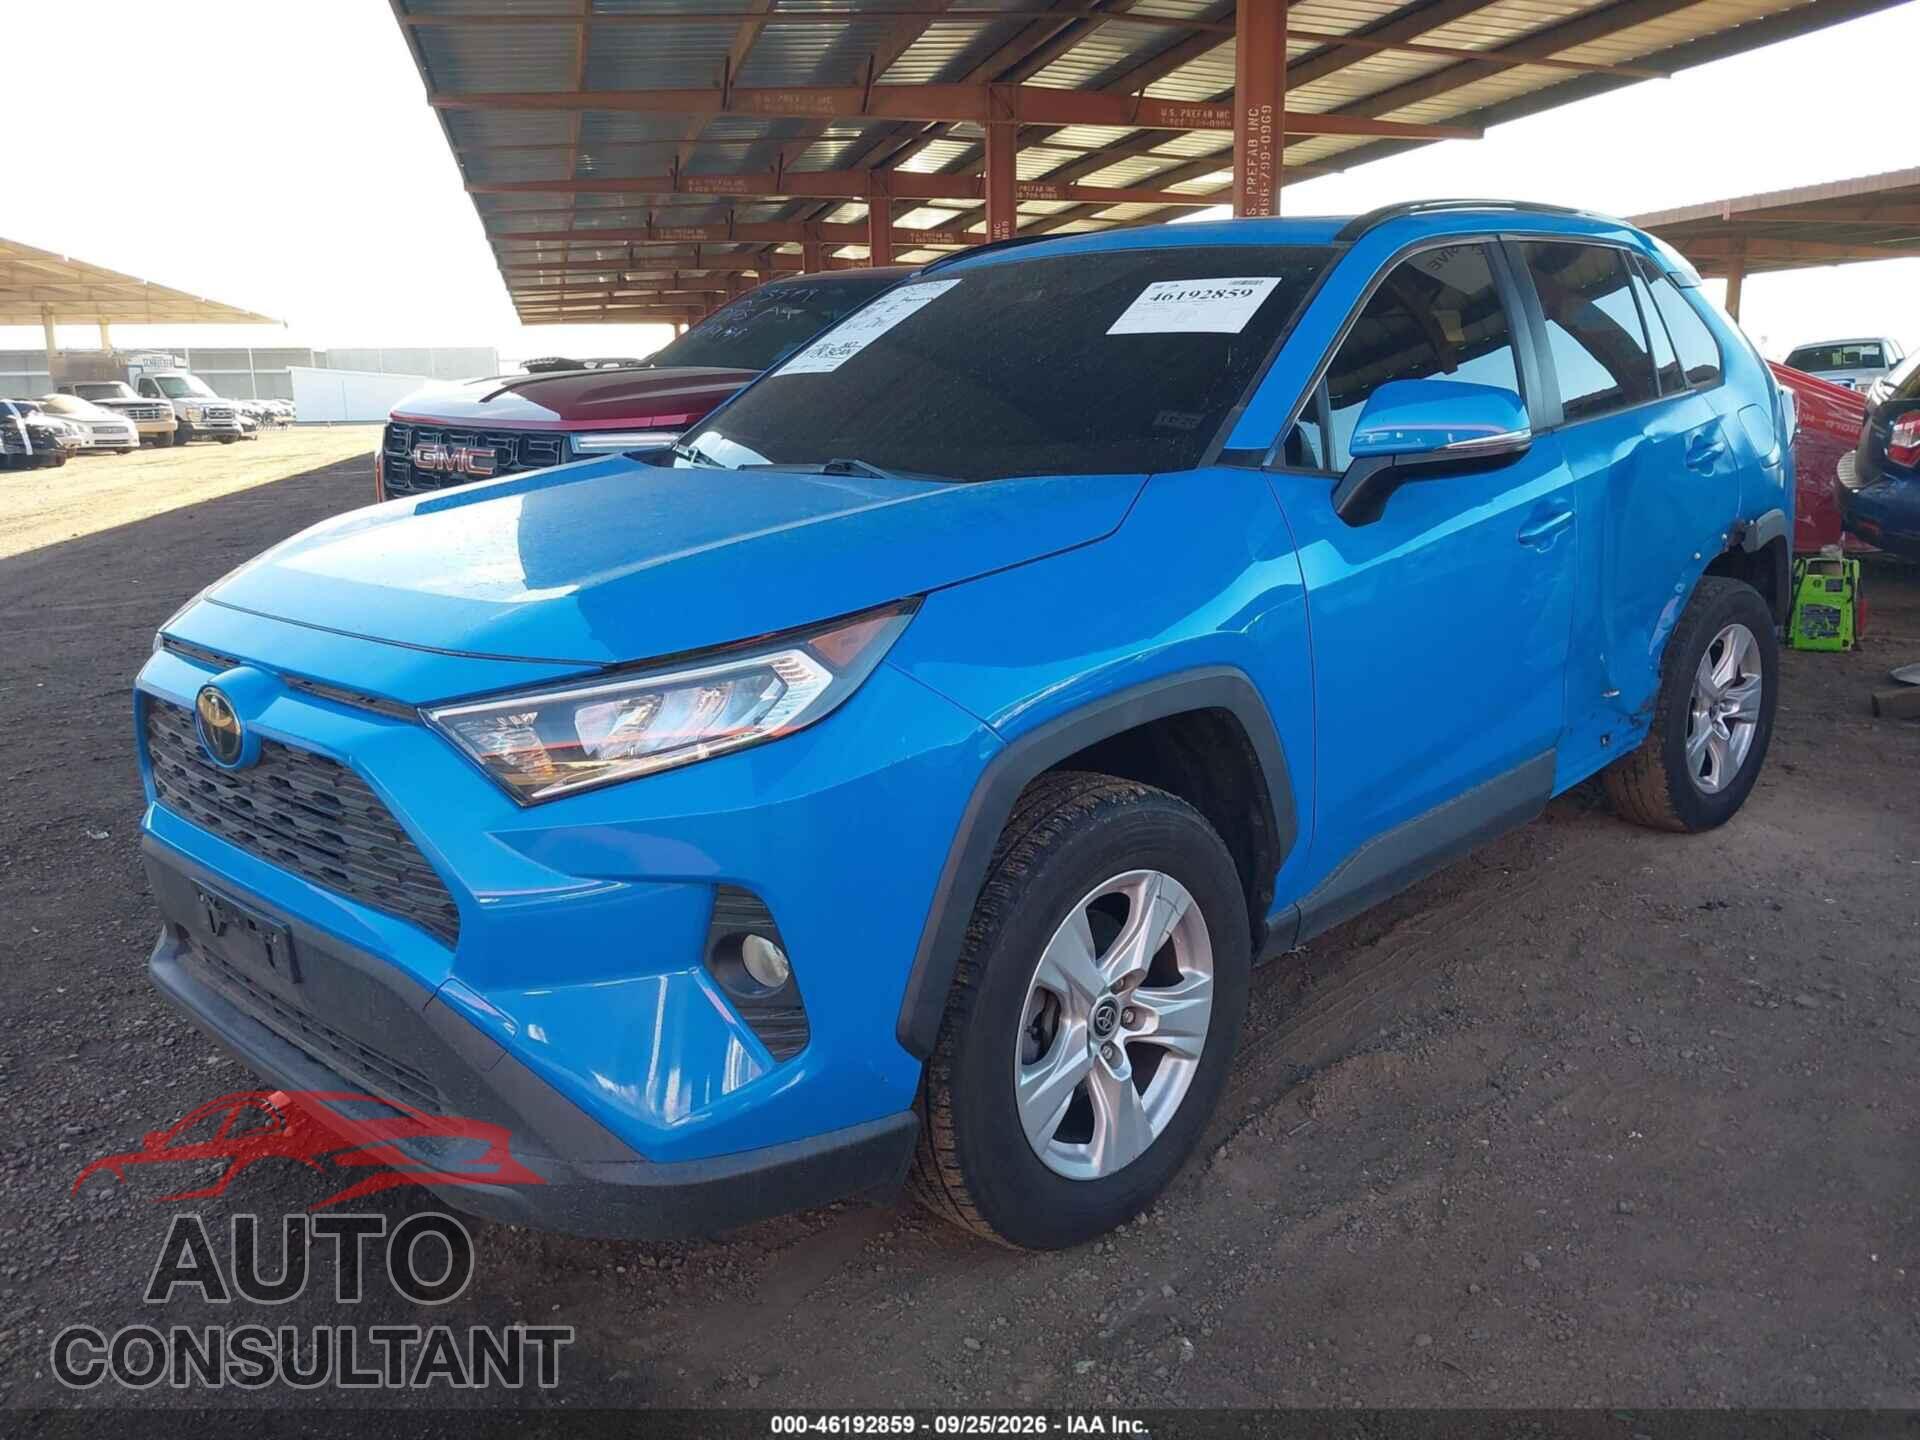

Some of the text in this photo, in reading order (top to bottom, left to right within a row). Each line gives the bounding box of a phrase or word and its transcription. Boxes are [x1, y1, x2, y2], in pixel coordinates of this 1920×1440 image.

[1247, 108, 1260, 131] INC
[1246, 138, 1259, 195] PREFAB
[1150, 288, 1254, 302] 46192859
[414, 443, 496, 475] GMC
